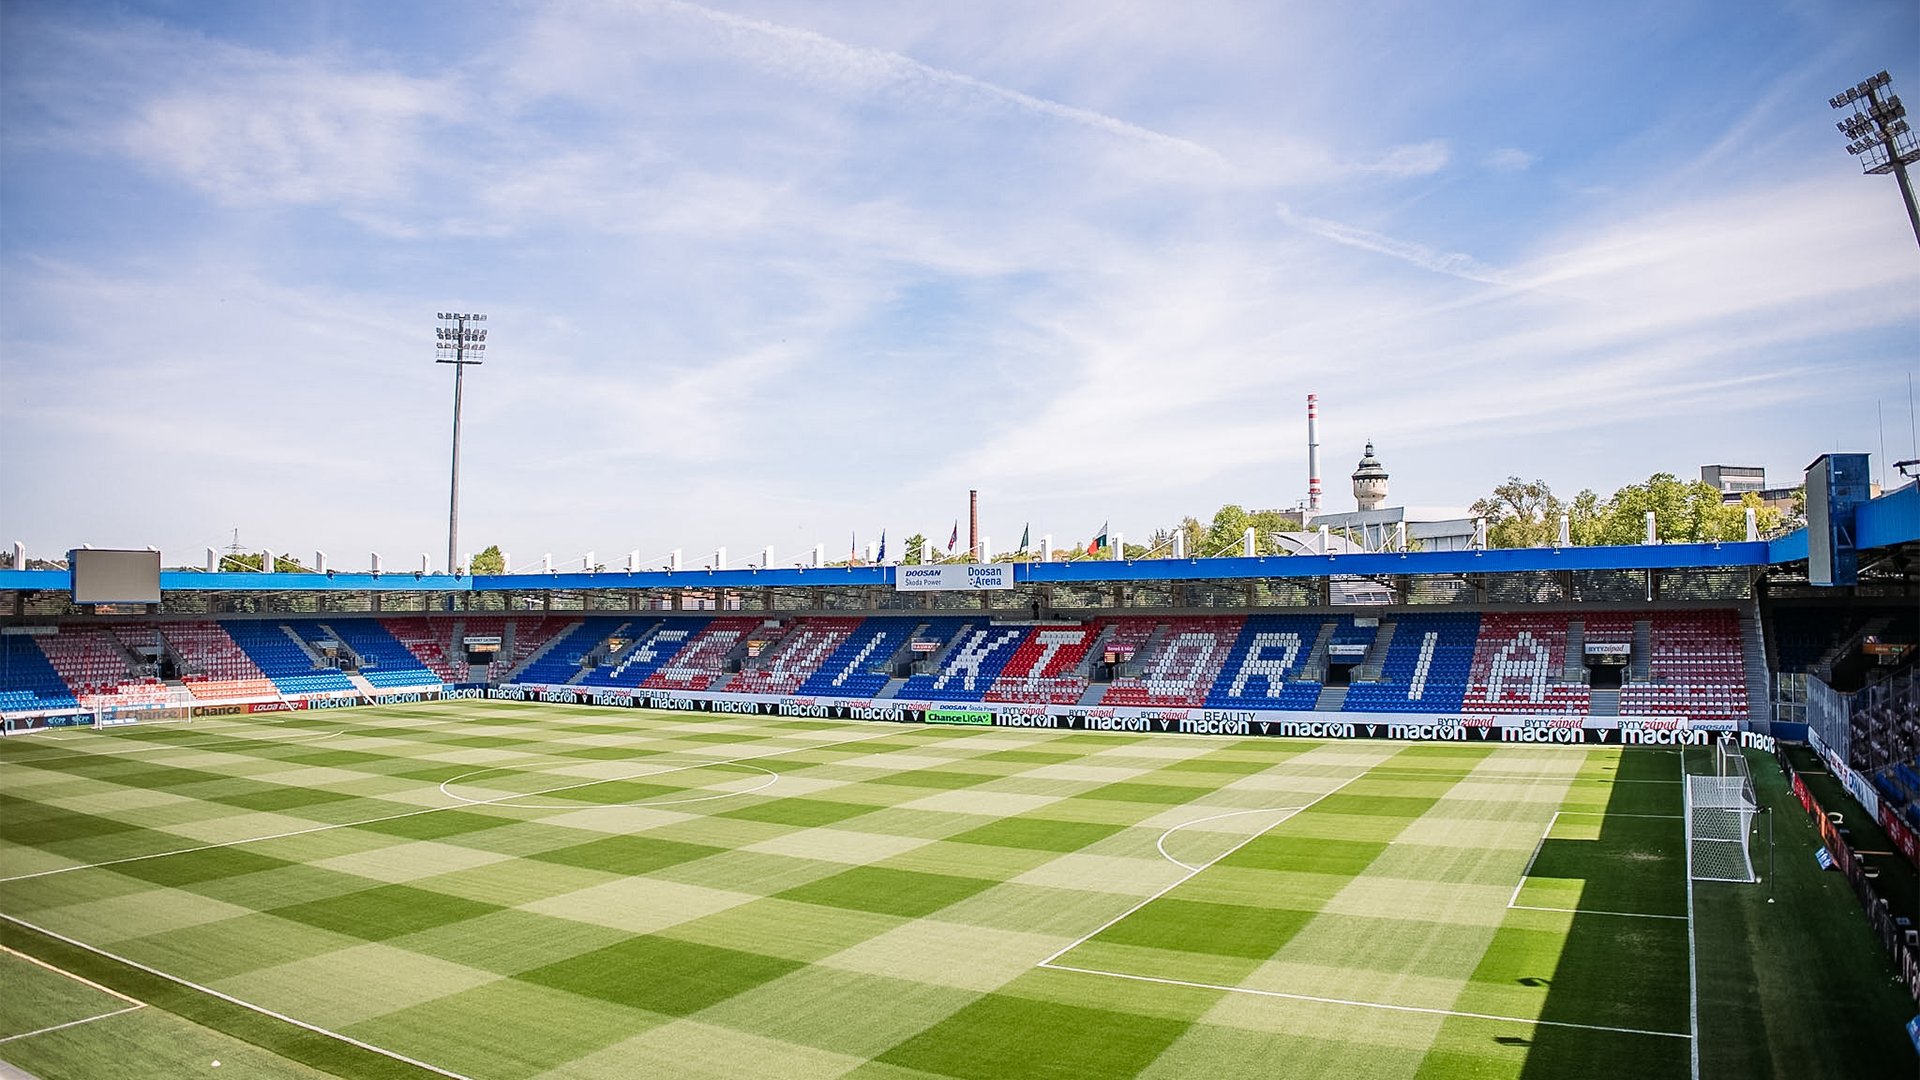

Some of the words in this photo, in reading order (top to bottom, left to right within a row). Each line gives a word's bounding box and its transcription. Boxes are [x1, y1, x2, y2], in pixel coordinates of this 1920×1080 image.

[968, 567, 1001, 576] Doosan
[905, 578, 922, 586] Škoda
[974, 577, 1001, 588] Arena
[376, 692, 420, 704] macron
[439, 687, 484, 700] macron
[488, 688, 525, 700] macron
[540, 690, 577, 703] macron
[308, 697, 356, 710] macron
[593, 694, 633, 707] macron
[651, 697, 693, 710] macron
[712, 700, 758, 713] macron
[193, 705, 241, 717] Chance
[779, 703, 828, 717] macron
[850, 706, 904, 720] macron
[1204, 711, 1255, 721] REALITY
[996, 713, 1057, 727] macron
[1085, 716, 1150, 731] macron
[1179, 719, 1249, 734] macron
[1280, 722, 1355, 737] macron
[1388, 724, 1467, 741] macron
[1501, 726, 1585, 743] macron
[1621, 728, 1708, 745] macron
